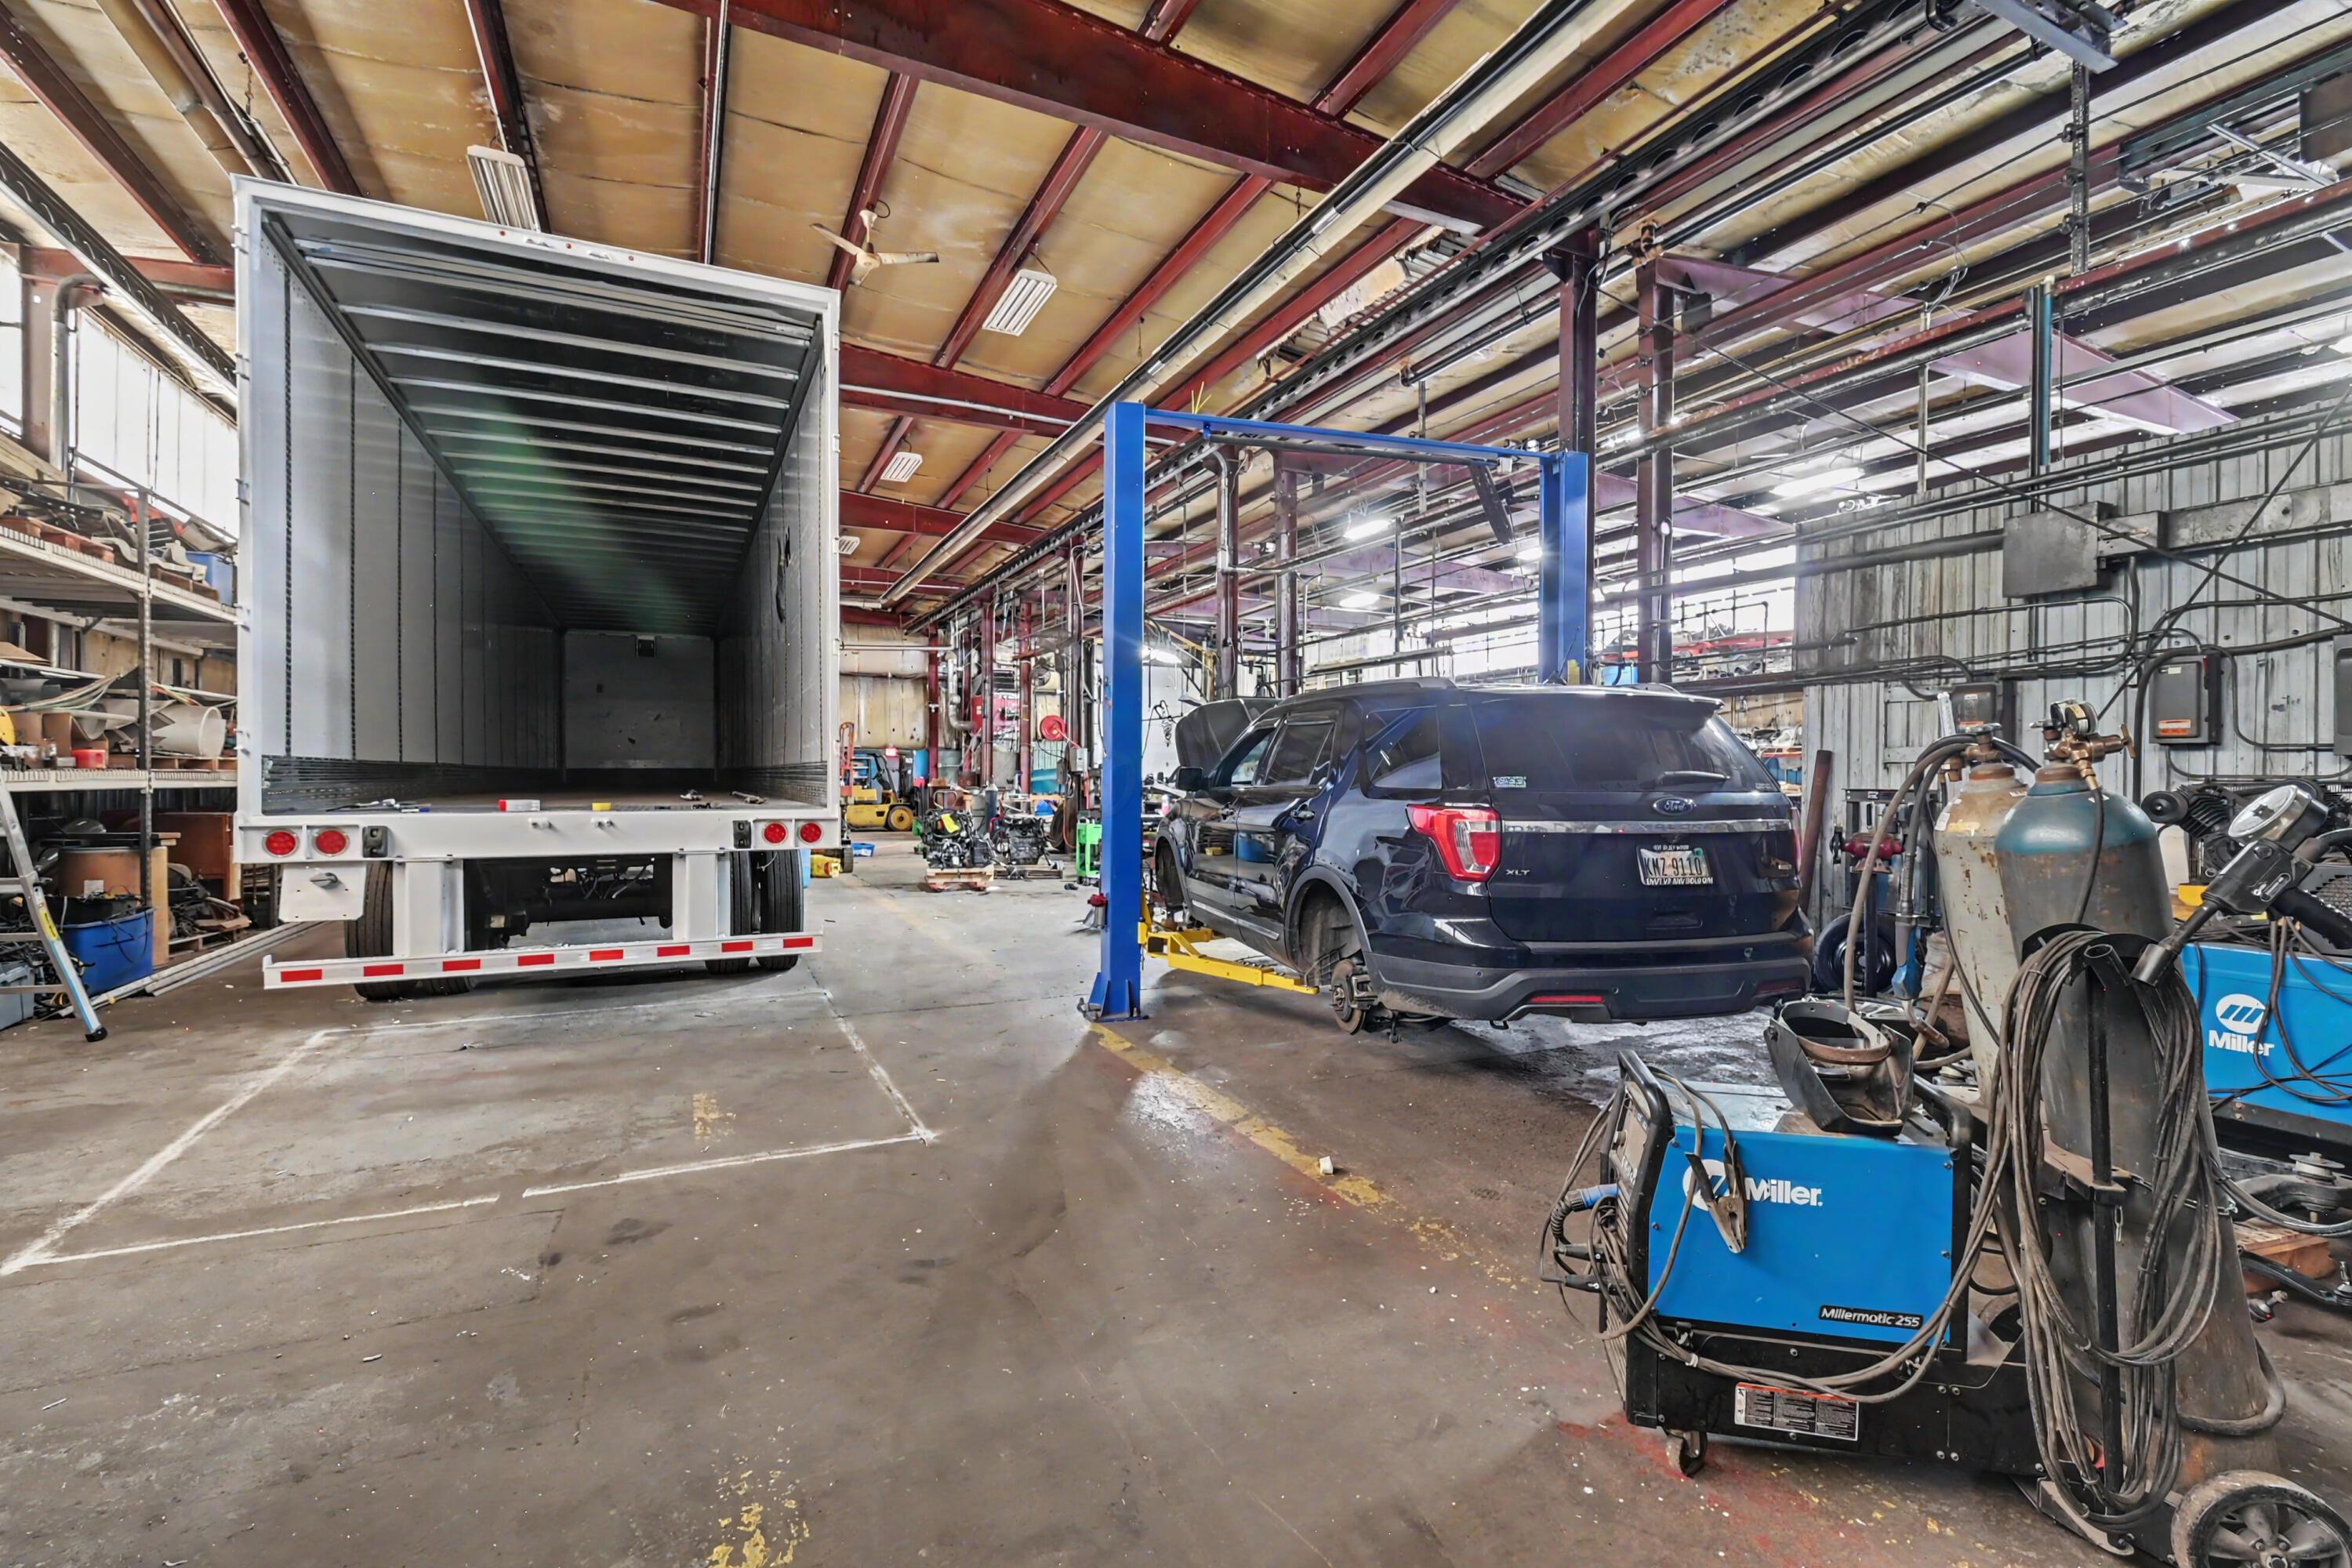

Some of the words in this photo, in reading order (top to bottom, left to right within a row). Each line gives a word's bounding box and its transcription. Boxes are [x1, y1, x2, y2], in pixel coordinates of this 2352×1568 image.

[1664, 800, 1686, 811] Ford
[1671, 857, 1703, 876] 9110
[2208, 1029, 2275, 1057] Miller
[1820, 1307, 1895, 1325] Millermatic
[1895, 1315, 1921, 1327] 255
